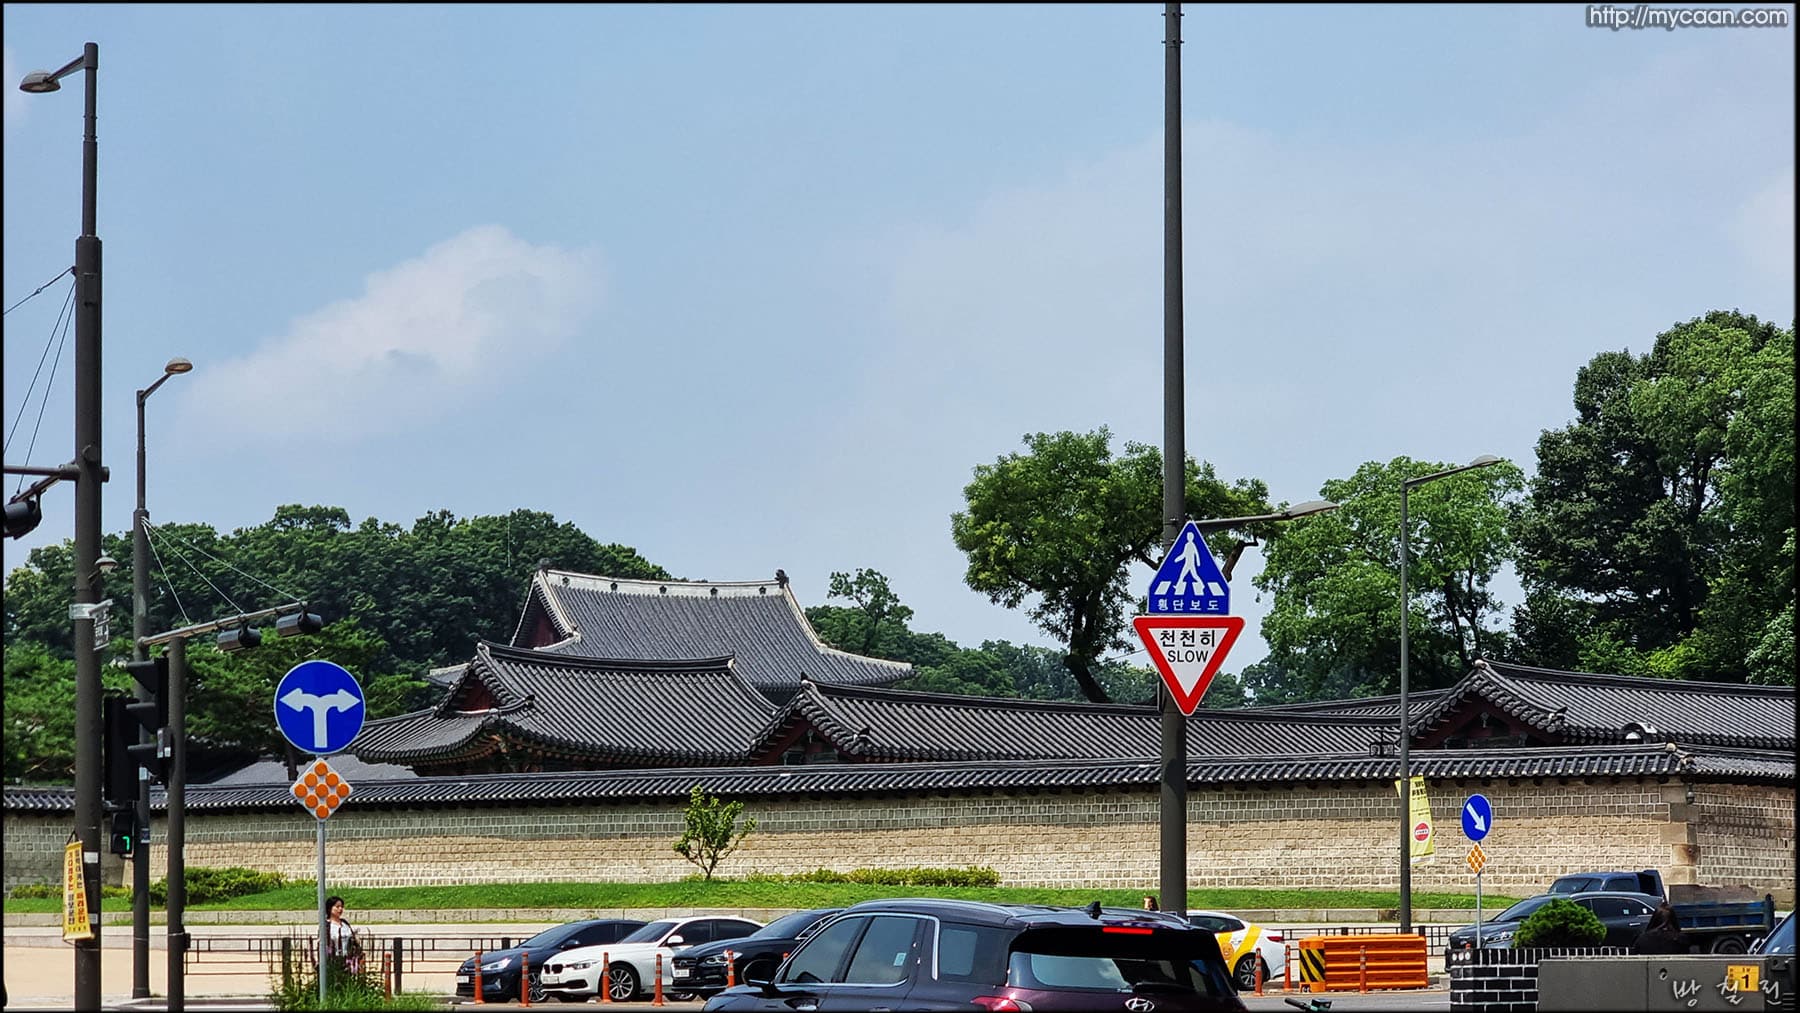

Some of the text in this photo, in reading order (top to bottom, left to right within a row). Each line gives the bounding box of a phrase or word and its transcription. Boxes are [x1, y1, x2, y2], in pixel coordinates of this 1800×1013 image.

[1157, 598, 1220, 611] 횡단보도
[1160, 630, 1216, 648] 천천히
[1167, 649, 1209, 663] SLOW
[1741, 974, 1749, 989] 1
